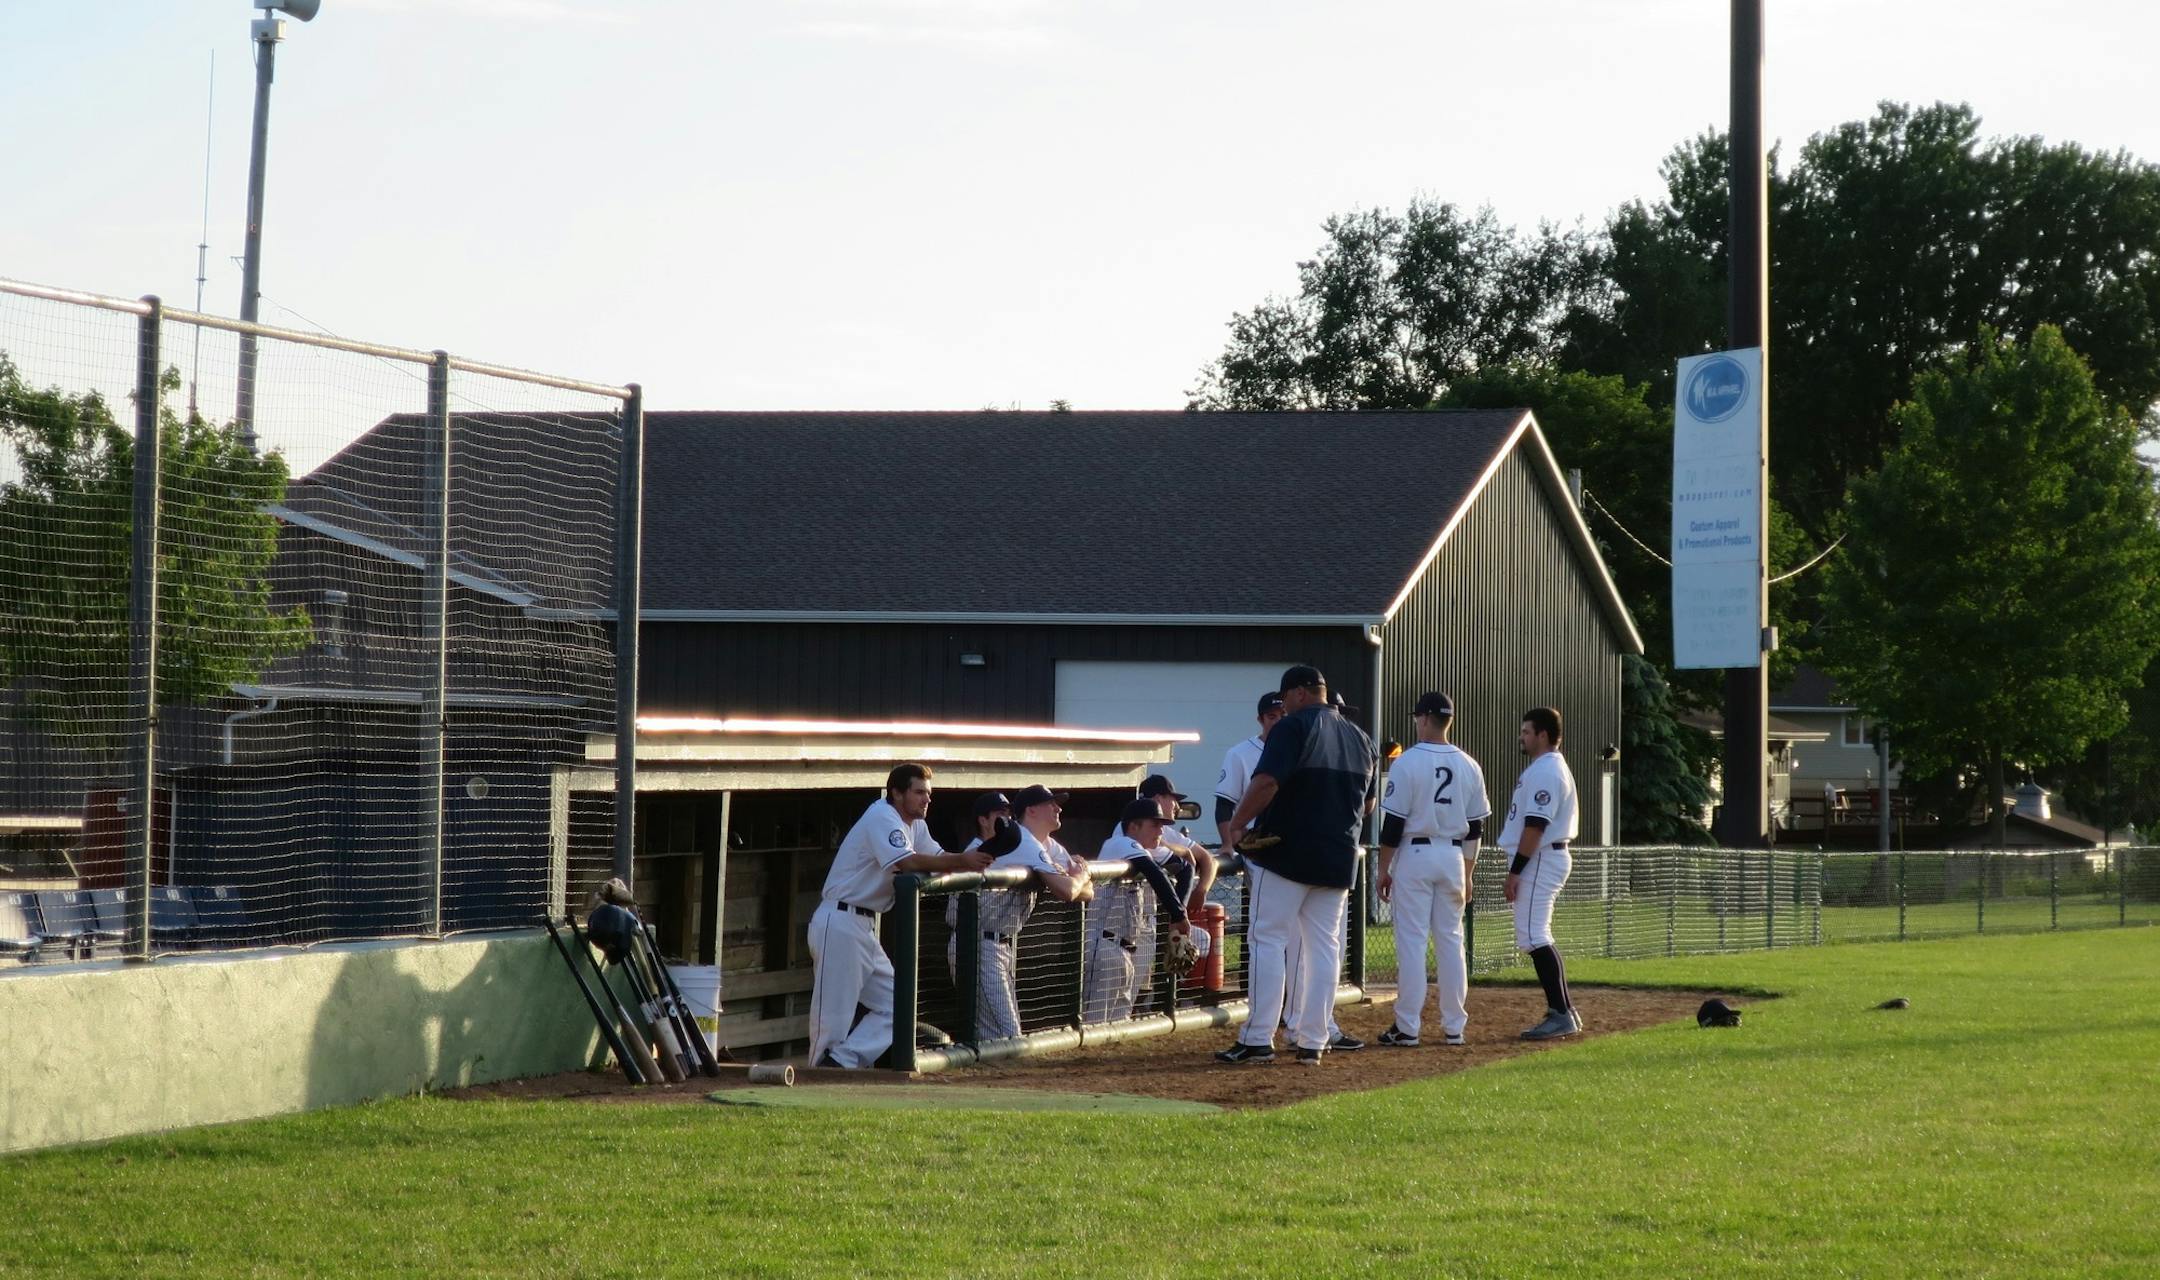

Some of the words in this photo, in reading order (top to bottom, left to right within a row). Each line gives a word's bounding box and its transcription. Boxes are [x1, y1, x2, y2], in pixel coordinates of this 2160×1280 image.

[1690, 520, 1713, 532] Custom
[1715, 517, 1740, 530] Apparel
[1685, 536, 1722, 548] Promotional
[1724, 535, 1751, 546] Products
[1434, 766, 1453, 805] 2
